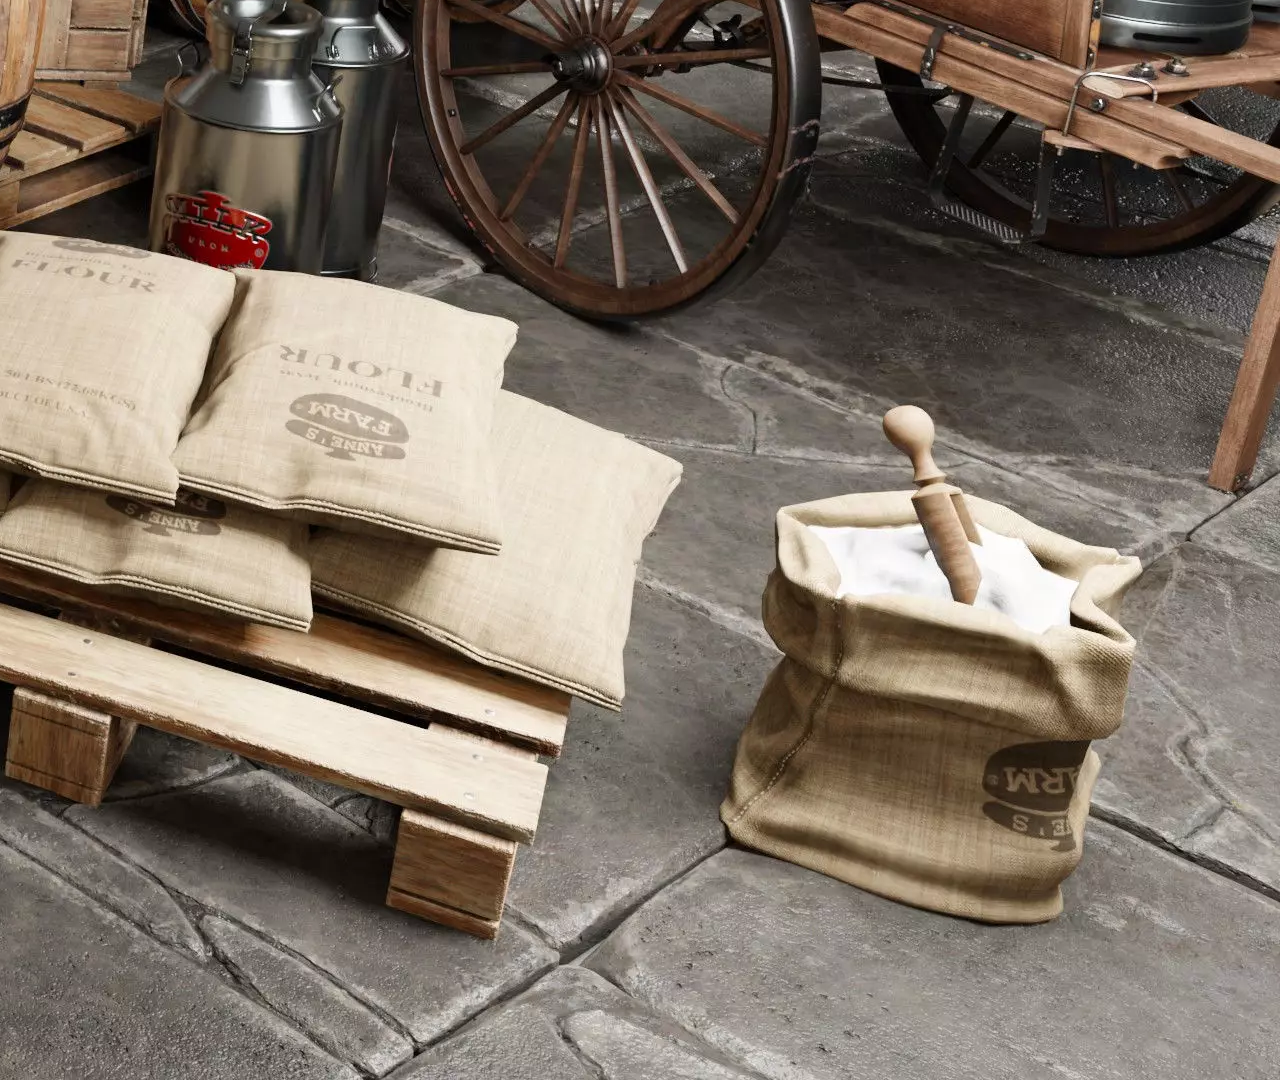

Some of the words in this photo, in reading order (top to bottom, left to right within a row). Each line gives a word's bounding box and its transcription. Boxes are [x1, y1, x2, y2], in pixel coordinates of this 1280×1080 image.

[11, 258, 156, 294] FLOUR
[279, 344, 450, 398] FLOUR
[307, 400, 394, 437] FARM
[305, 427, 385, 456] ANNE'S
[124, 502, 201, 534] ANNE'S
